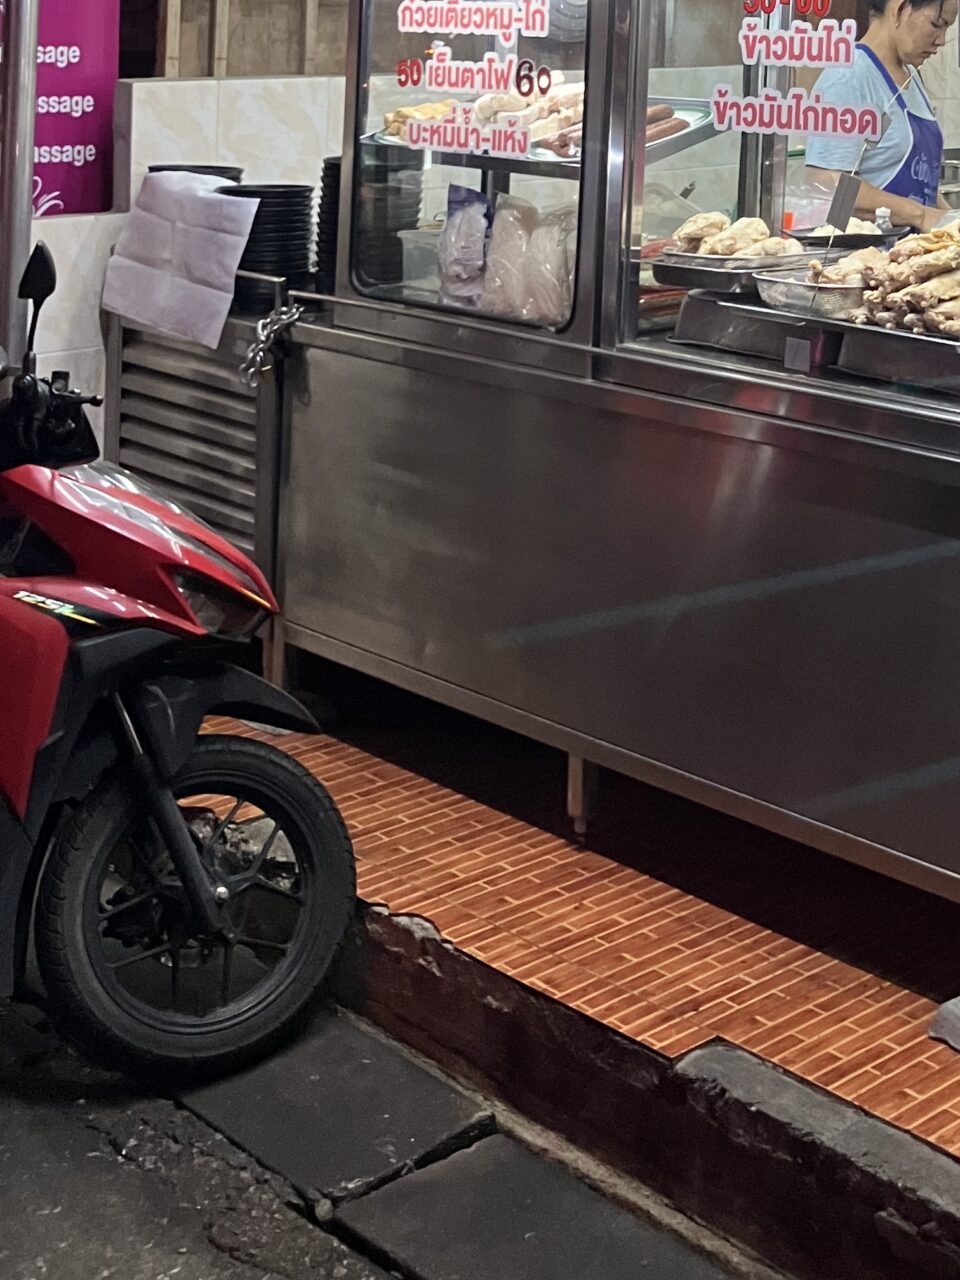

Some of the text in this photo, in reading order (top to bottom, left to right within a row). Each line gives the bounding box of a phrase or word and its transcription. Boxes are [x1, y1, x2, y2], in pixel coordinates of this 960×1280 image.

[36, 45, 81, 68] sage
[742, 23, 852, 64] ข้าวมันไก่
[396, 52, 552, 97] 50 เย็นตาโฟ 60
[37, 95, 95, 118] ssage
[713, 88, 878, 136] ข้าวมันไก่ทอด
[408, 107, 529, 154] บะหมี่น้ำ-แห้ง
